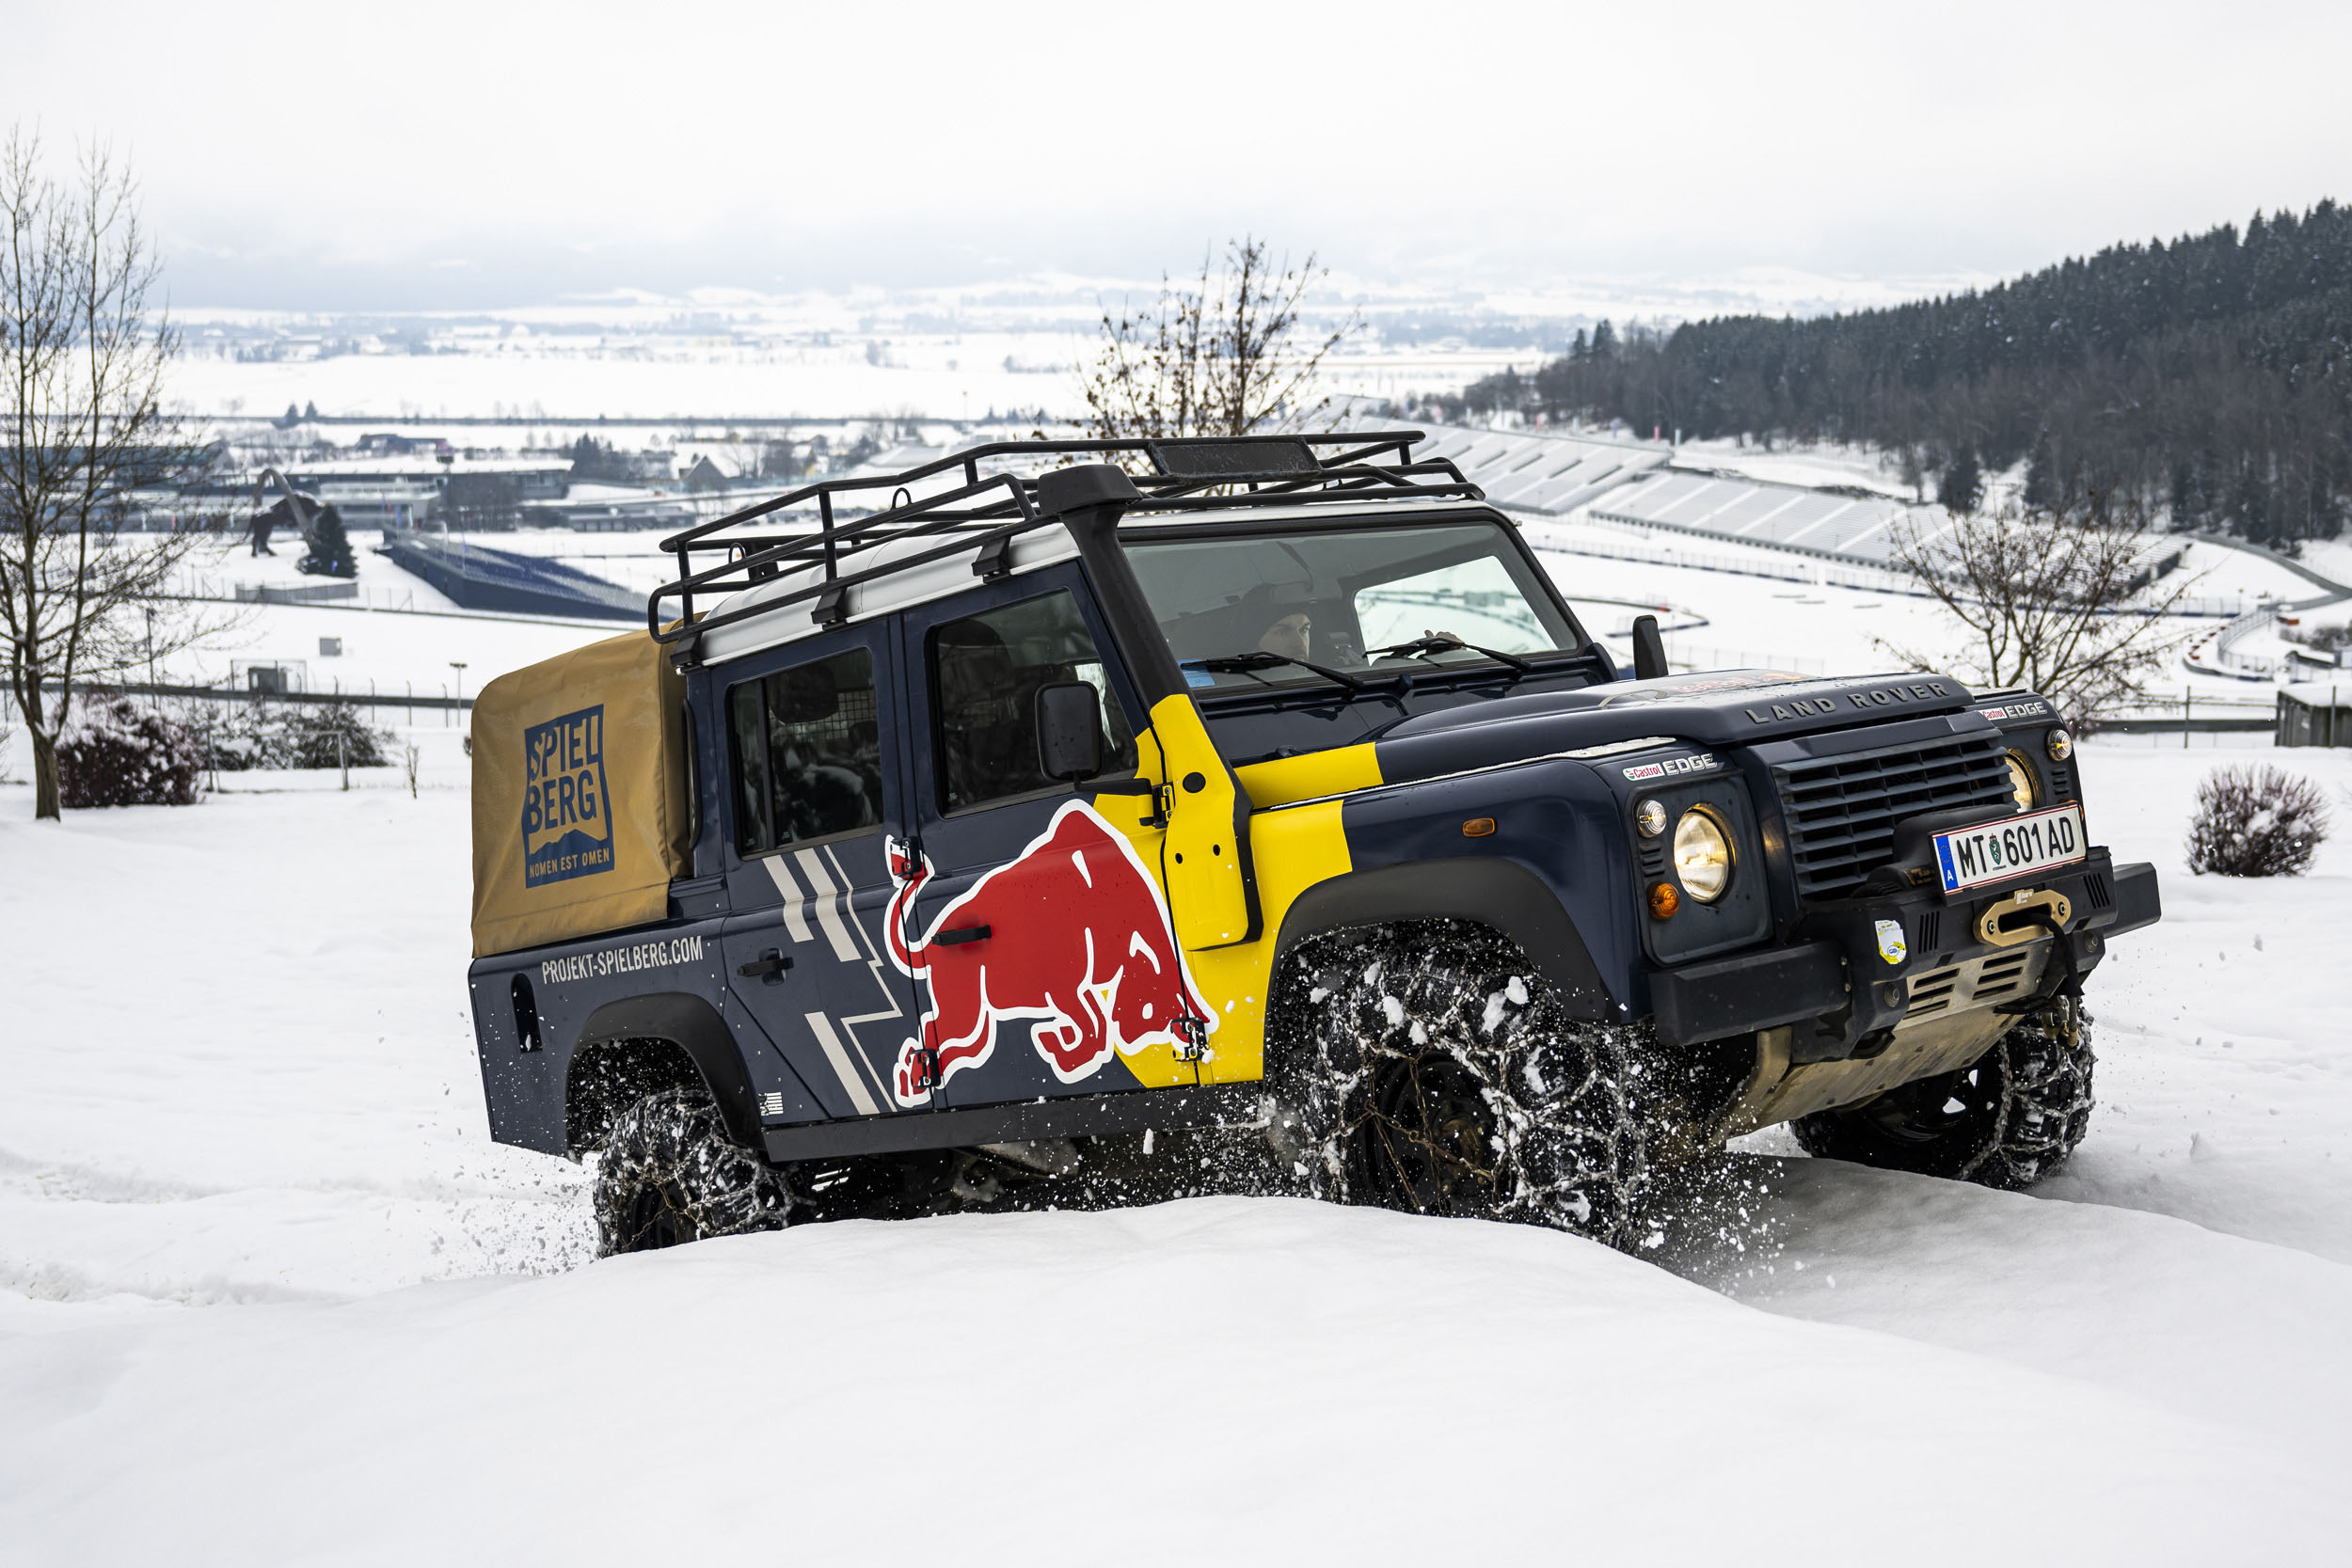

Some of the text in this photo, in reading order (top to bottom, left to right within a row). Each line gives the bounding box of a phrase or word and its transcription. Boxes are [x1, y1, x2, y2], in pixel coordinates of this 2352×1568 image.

[1745, 682, 1949, 723] LAND ROVER
[2005, 702, 2047, 719] EDGE
[530, 714, 599, 782] SPIEL
[1632, 753, 1718, 779] Castrol EDGE
[527, 769, 597, 834] BERG
[529, 847, 610, 879] NOMEN EST OMEN
[1956, 835, 1988, 879] MT
[2003, 822, 2044, 866] 601
[2048, 816, 2075, 858] AD
[1947, 870, 1954, 881] A
[542, 936, 703, 984] PROJEKT-SPIELBERG.COM
